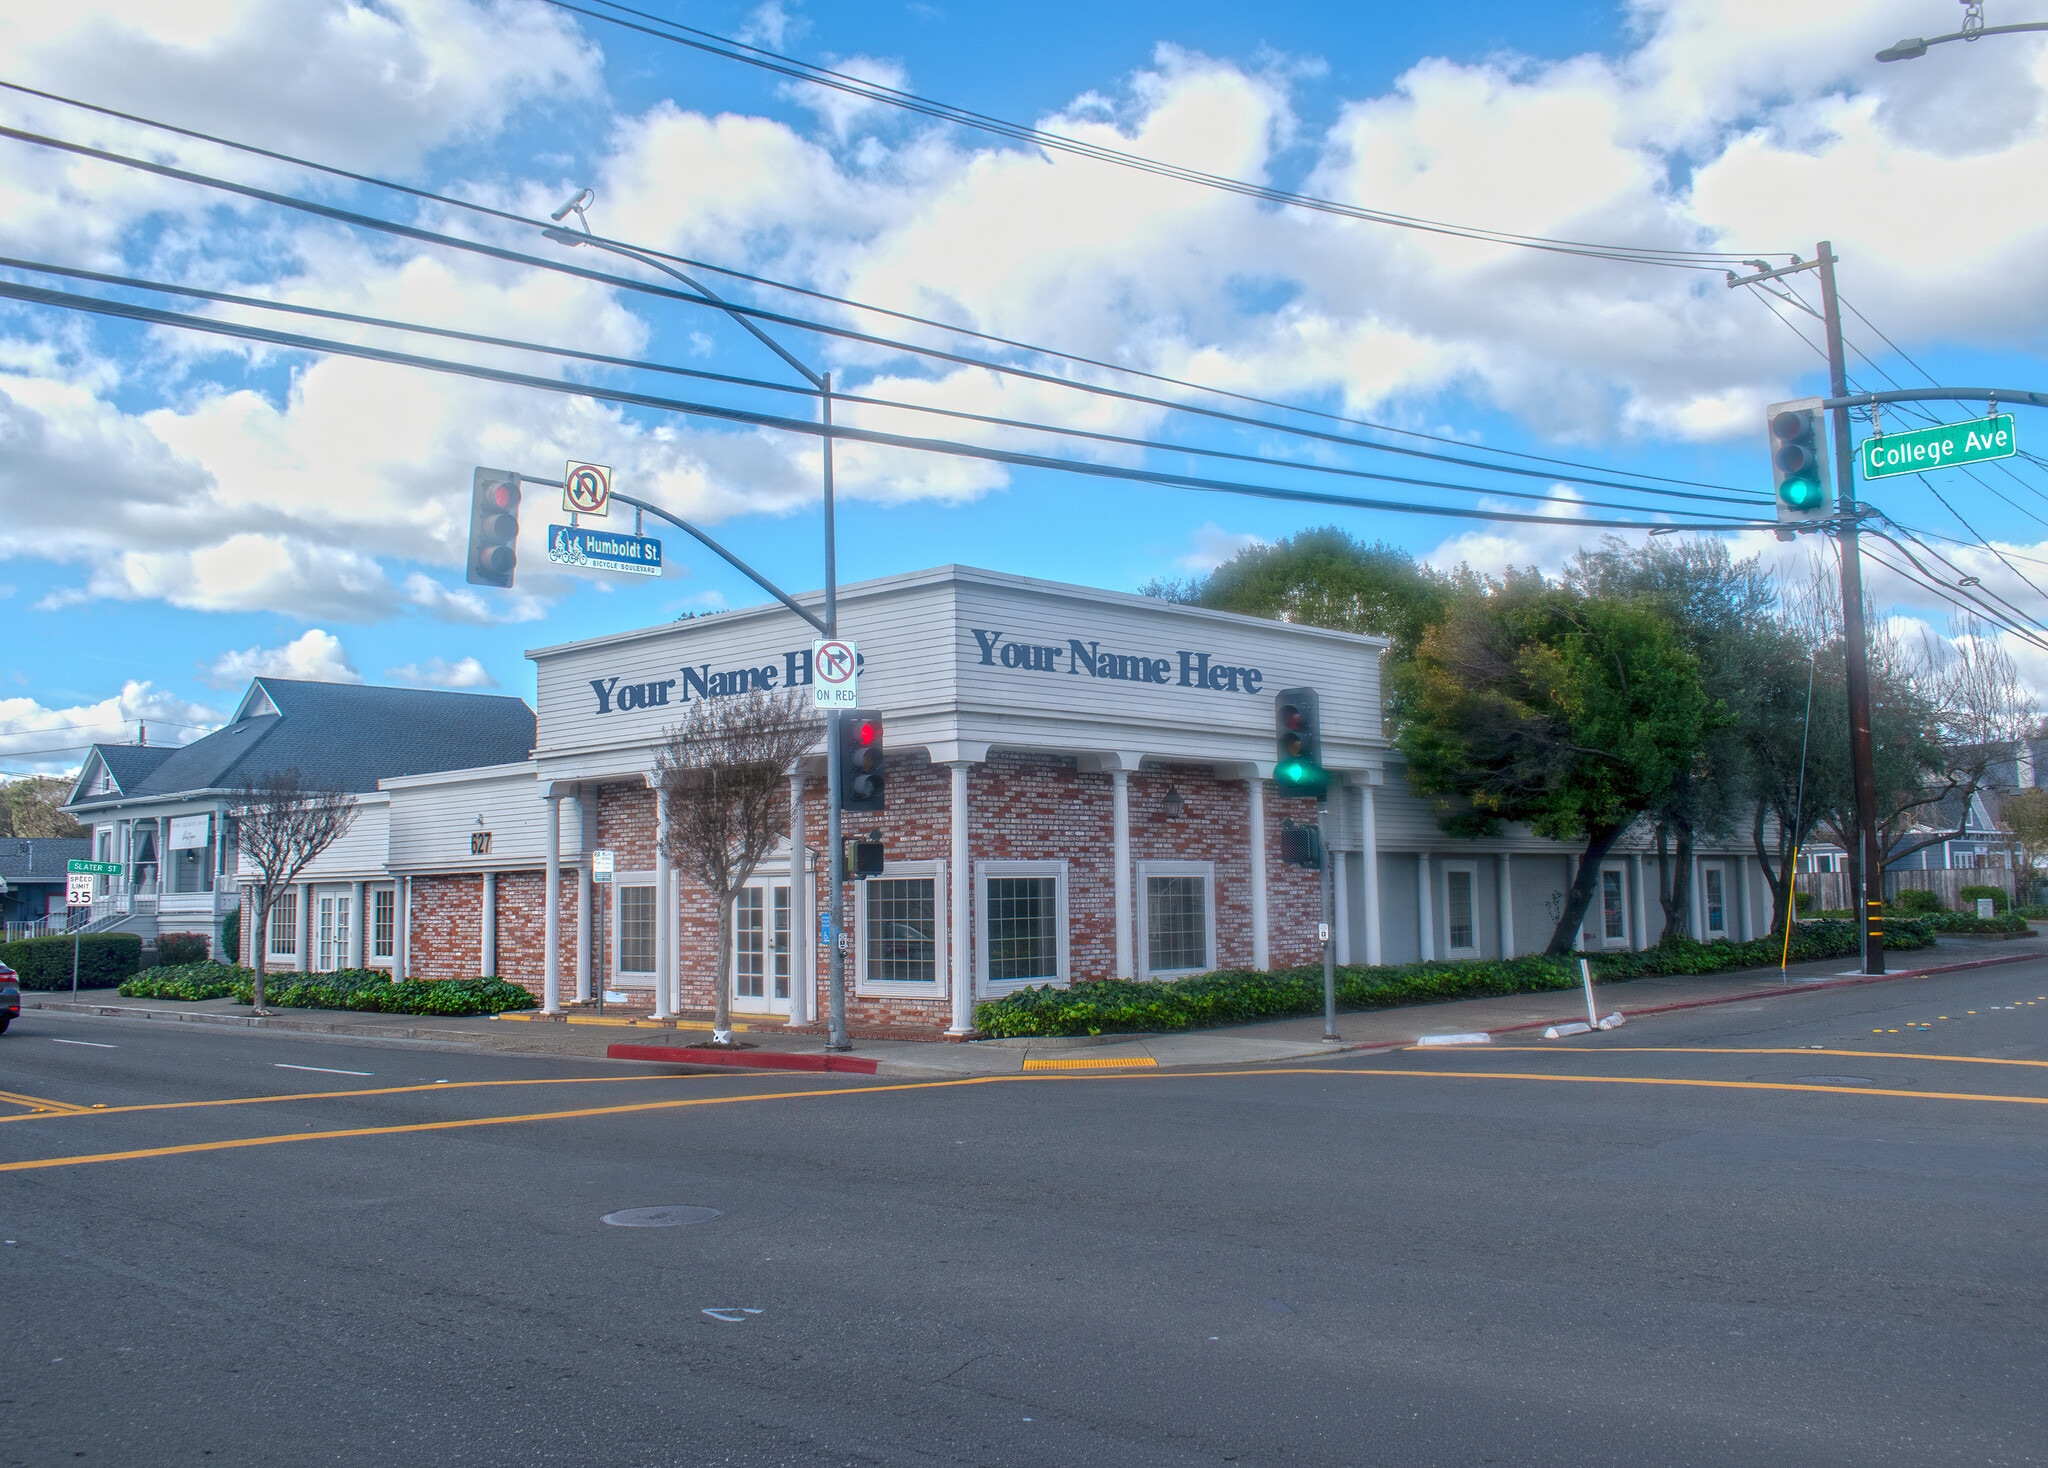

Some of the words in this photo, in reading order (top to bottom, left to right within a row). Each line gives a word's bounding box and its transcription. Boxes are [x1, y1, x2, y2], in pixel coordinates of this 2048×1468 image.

[1870, 439, 1954, 468] College
[1965, 430, 2008, 453] Ave
[586, 535, 641, 559] Humboldt
[644, 543, 660, 561] St.
[592, 560, 618, 570] BICYCLE
[620, 563, 656, 574] BOULEVARD
[970, 628, 1063, 673] Your
[1066, 638, 1171, 685] Name
[1175, 650, 1263, 695] Here
[589, 676, 676, 715] Your
[679, 663, 779, 703] Name
[816, 689, 830, 701] ON
[835, 689, 855, 701] RED
[471, 831, 491, 854] 627
[73, 862, 103, 872] SLATER
[107, 865, 117, 873] ST
[70, 875, 93, 883] SPEED
[69, 891, 91, 903] 35
